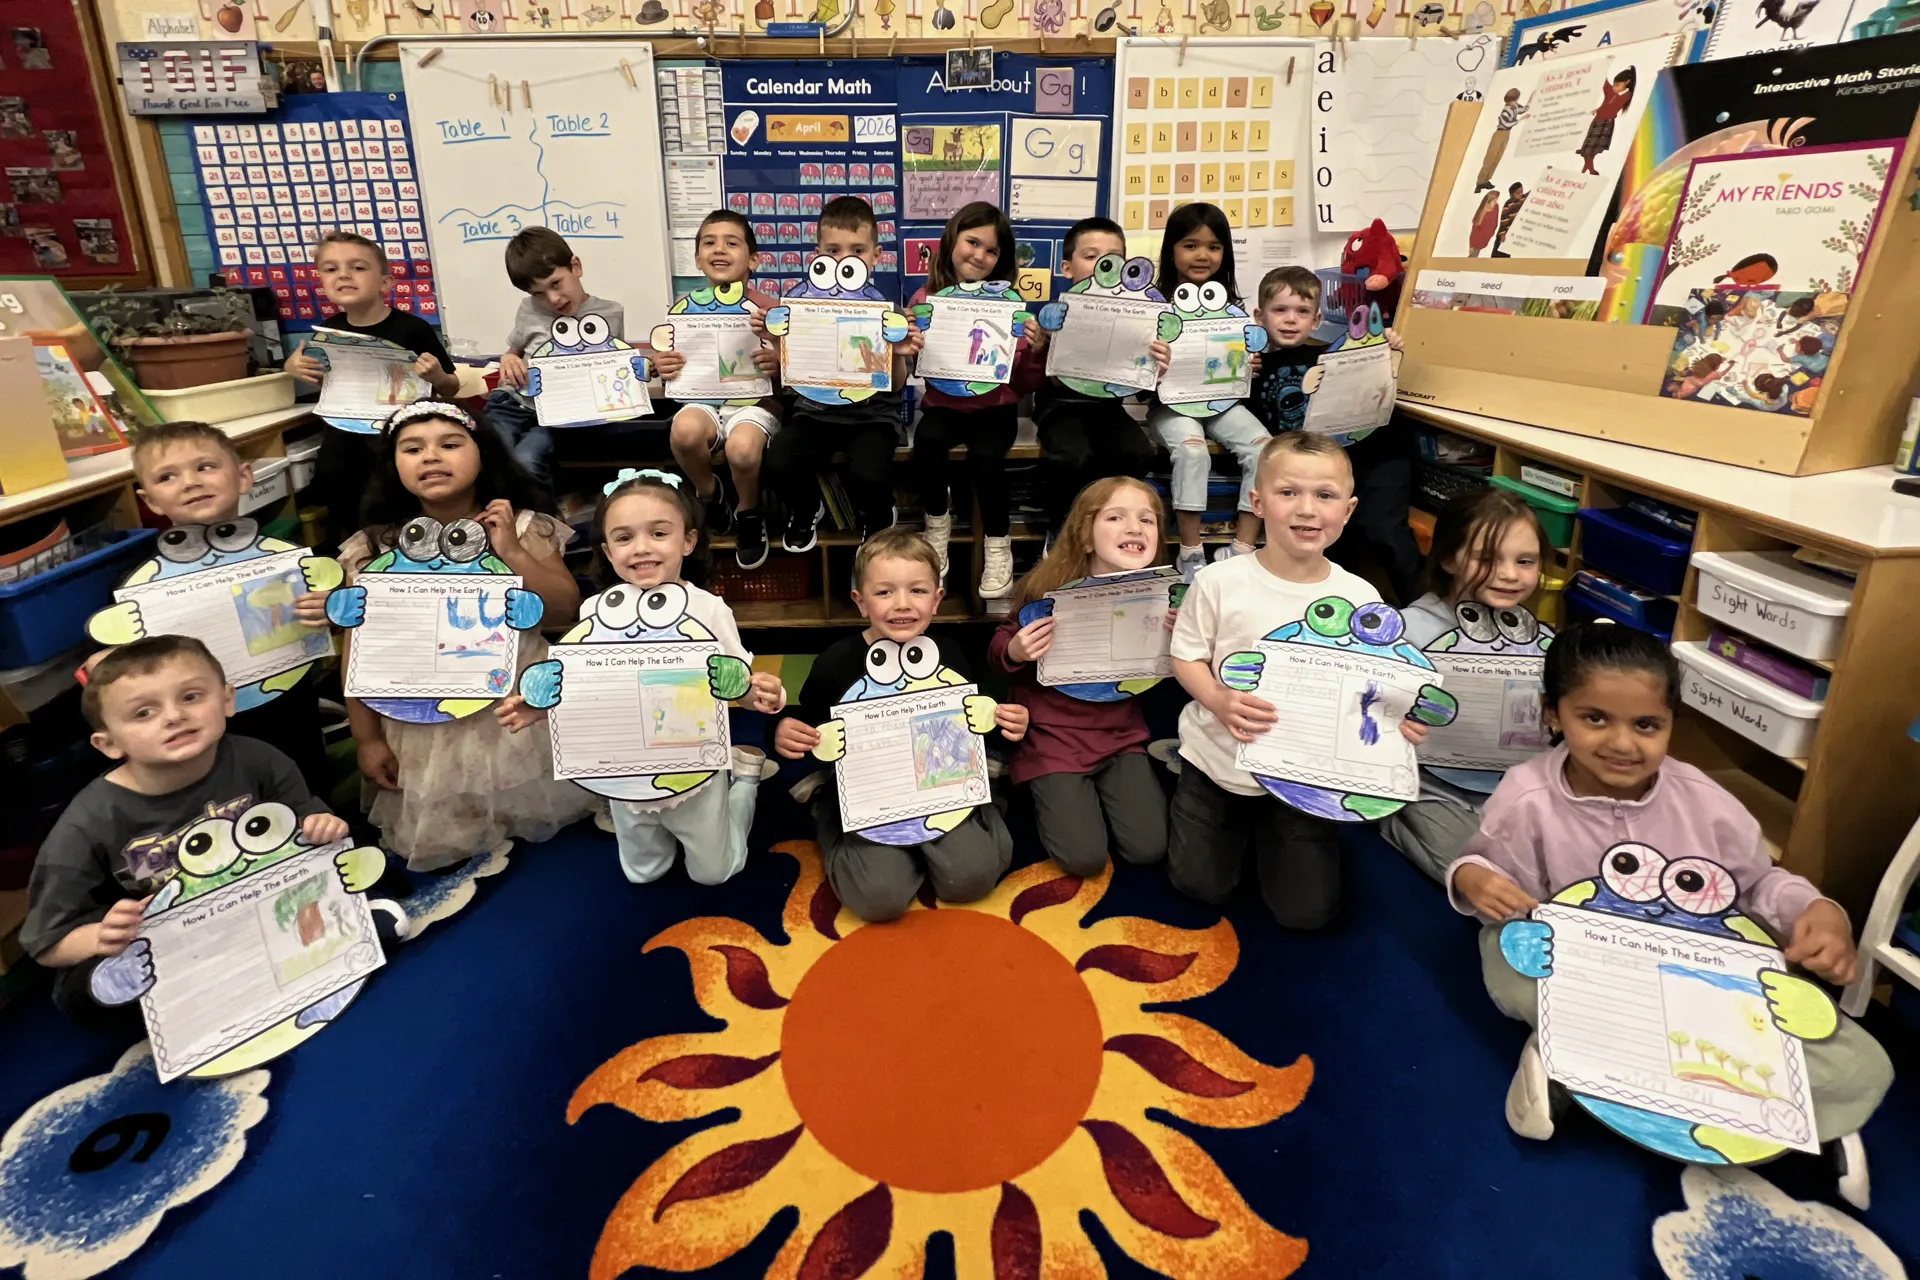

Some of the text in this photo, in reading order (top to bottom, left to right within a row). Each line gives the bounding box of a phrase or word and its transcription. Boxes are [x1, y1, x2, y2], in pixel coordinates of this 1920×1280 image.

[148, 18, 196, 38] Alphabet
[1597, 31, 1611, 47] A
[128, 48, 247, 92] TGIF
[1318, 52, 1336, 73] a
[747, 78, 871, 94] Calendar Math
[1754, 64, 1920, 95] Interactive Math Storie
[1836, 79, 1920, 96] Kindergarte
[1040, 73, 1072, 107] Gg
[1161, 87, 1168, 97] b
[1209, 87, 1216, 96] d
[142, 98, 176, 110] Thank
[179, 98, 200, 110] God
[225, 97, 250, 108] Free
[1318, 91, 1333, 112] e
[203, 131, 208, 139] 1
[225, 130, 232, 139] 2
[245, 130, 251, 138] 3
[290, 128, 296, 136] 5
[309, 128, 316, 136] 6
[347, 125, 354, 133] 8
[369, 125, 376, 133] 9
[390, 125, 400, 133] 10
[436, 117, 506, 138] Table 1
[546, 113, 609, 132] Table 2
[795, 122, 821, 136] April
[857, 117, 895, 136] 2026
[906, 129, 931, 153] Gg
[1319, 127, 1327, 152] i
[392, 146, 405, 154] 20
[1025, 127, 1084, 174] G g
[395, 166, 408, 174] 30
[1207, 174, 1214, 184] p
[1229, 175, 1240, 183] qu
[1317, 167, 1332, 187] o
[1561, 178, 1587, 190] good
[1717, 181, 1844, 203] MY FRIENDS
[403, 206, 416, 214] 50
[1318, 204, 1333, 223] u
[1546, 200, 1565, 210] also
[1776, 206, 1835, 215] TARO GOMI
[458, 215, 522, 237] Table 3
[552, 212, 619, 233] Table 4
[1019, 274, 1042, 299] Gg
[1437, 277, 1456, 288] bloo
[1481, 281, 1502, 291] seed
[1553, 285, 1574, 295] root
[420, 302, 435, 310] 100
[1396, 388, 1436, 401] CHILDCRAFT
[166, 588, 187, 597] How
[195, 580, 214, 590] Can
[215, 574, 234, 586] Help
[236, 571, 251, 581] The
[252, 565, 276, 575] Earth
[430, 587, 446, 595] Help
[1712, 585, 1797, 630] Sight Words
[586, 659, 603, 667] How
[611, 658, 626, 666] Can
[628, 657, 645, 666] Help
[647, 657, 661, 665] The
[1289, 656, 1396, 680] How I Can Help The Earth
[865, 712, 879, 720] How
[886, 709, 899, 717] Can
[901, 706, 914, 715] Help
[928, 700, 946, 708] Earth
[1690, 682, 1768, 733] Sight Words
[182, 868, 309, 927] How I Can Help The Earth
[1584, 929, 1726, 968] How I Can Help The Earth
